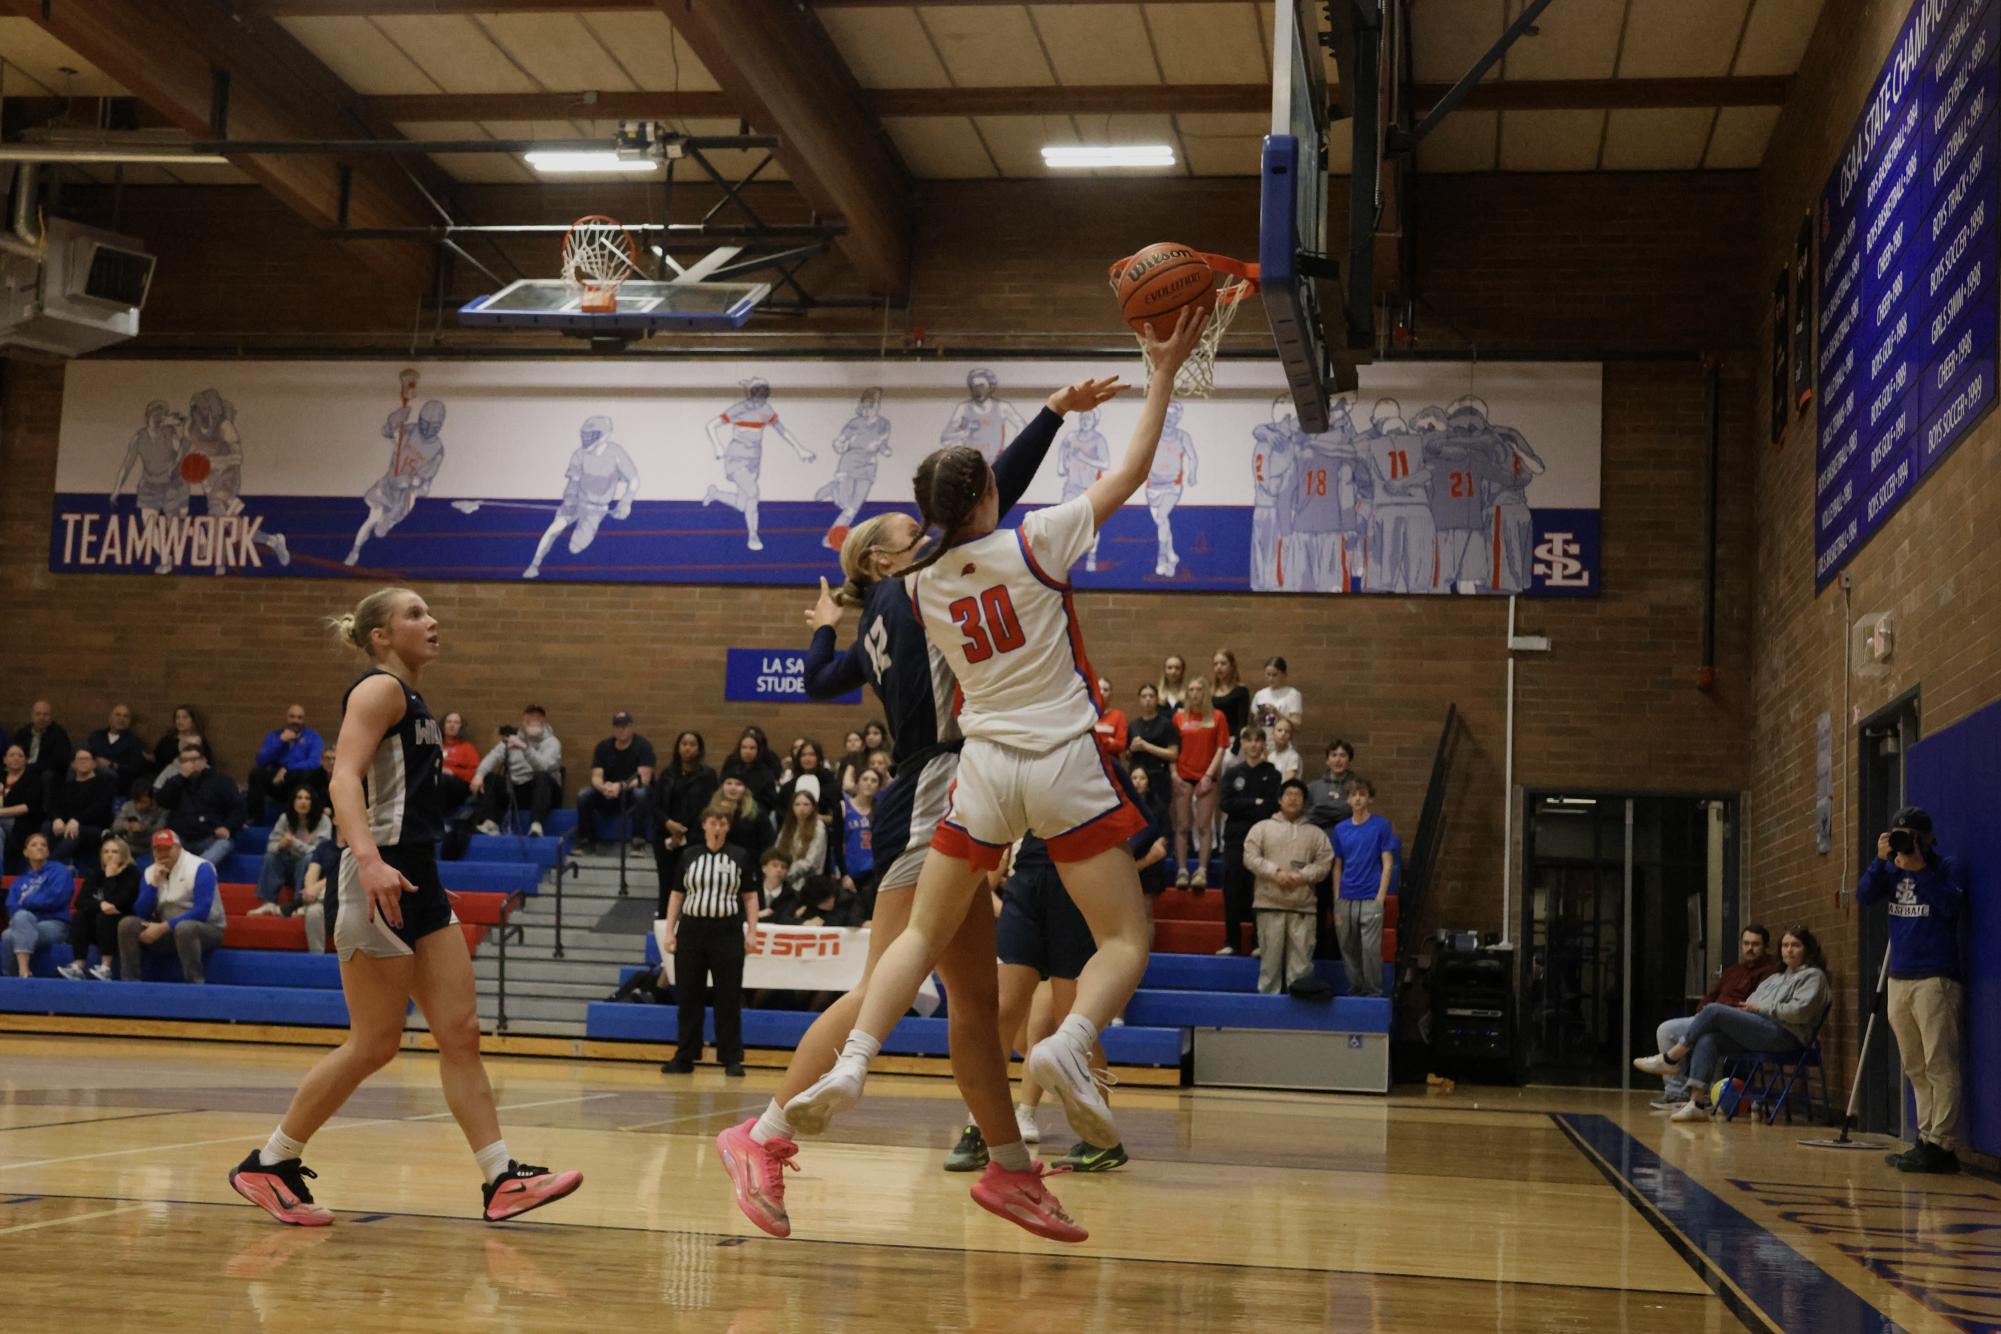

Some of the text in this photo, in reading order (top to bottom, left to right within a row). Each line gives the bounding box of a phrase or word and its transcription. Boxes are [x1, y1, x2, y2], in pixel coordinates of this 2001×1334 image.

[1935, 5, 1969, 82] VOLLEYBALL
[1840, 0, 1947, 207] OSAA STATE CHAMPIO
[1934, 59, 1968, 135] VOLLEYBALL
[1933, 113, 1967, 188] VOLLEYBALL
[1877, 172, 1904, 233] BASKETBALL
[1932, 201, 1946, 240] BOYS
[1948, 171, 1966, 216] TRACK
[1127, 248, 1193, 282] Wilson
[1930, 258, 1944, 294] BOYS
[1945, 224, 1967, 273] SOCCER
[1145, 271, 1202, 305] EVOLUTION
[1931, 307, 1946, 344] GIRLS
[1937, 349, 1955, 389] CHEER
[1928, 374, 1981, 452] BOYS SOCCER 1999
[1306, 469, 1328, 496] 18
[1388, 449, 1409, 480] 11
[1450, 471, 1474, 497] 21
[1867, 494, 1878, 520] BOYS
[1878, 473, 1895, 507] SOCCER
[61, 513, 264, 567] TEAMWORK
[948, 584, 1026, 664] 30
[756, 676, 806, 692] STUDE
[762, 657, 805, 674] LA SA
[748, 931, 840, 957] ESPN
